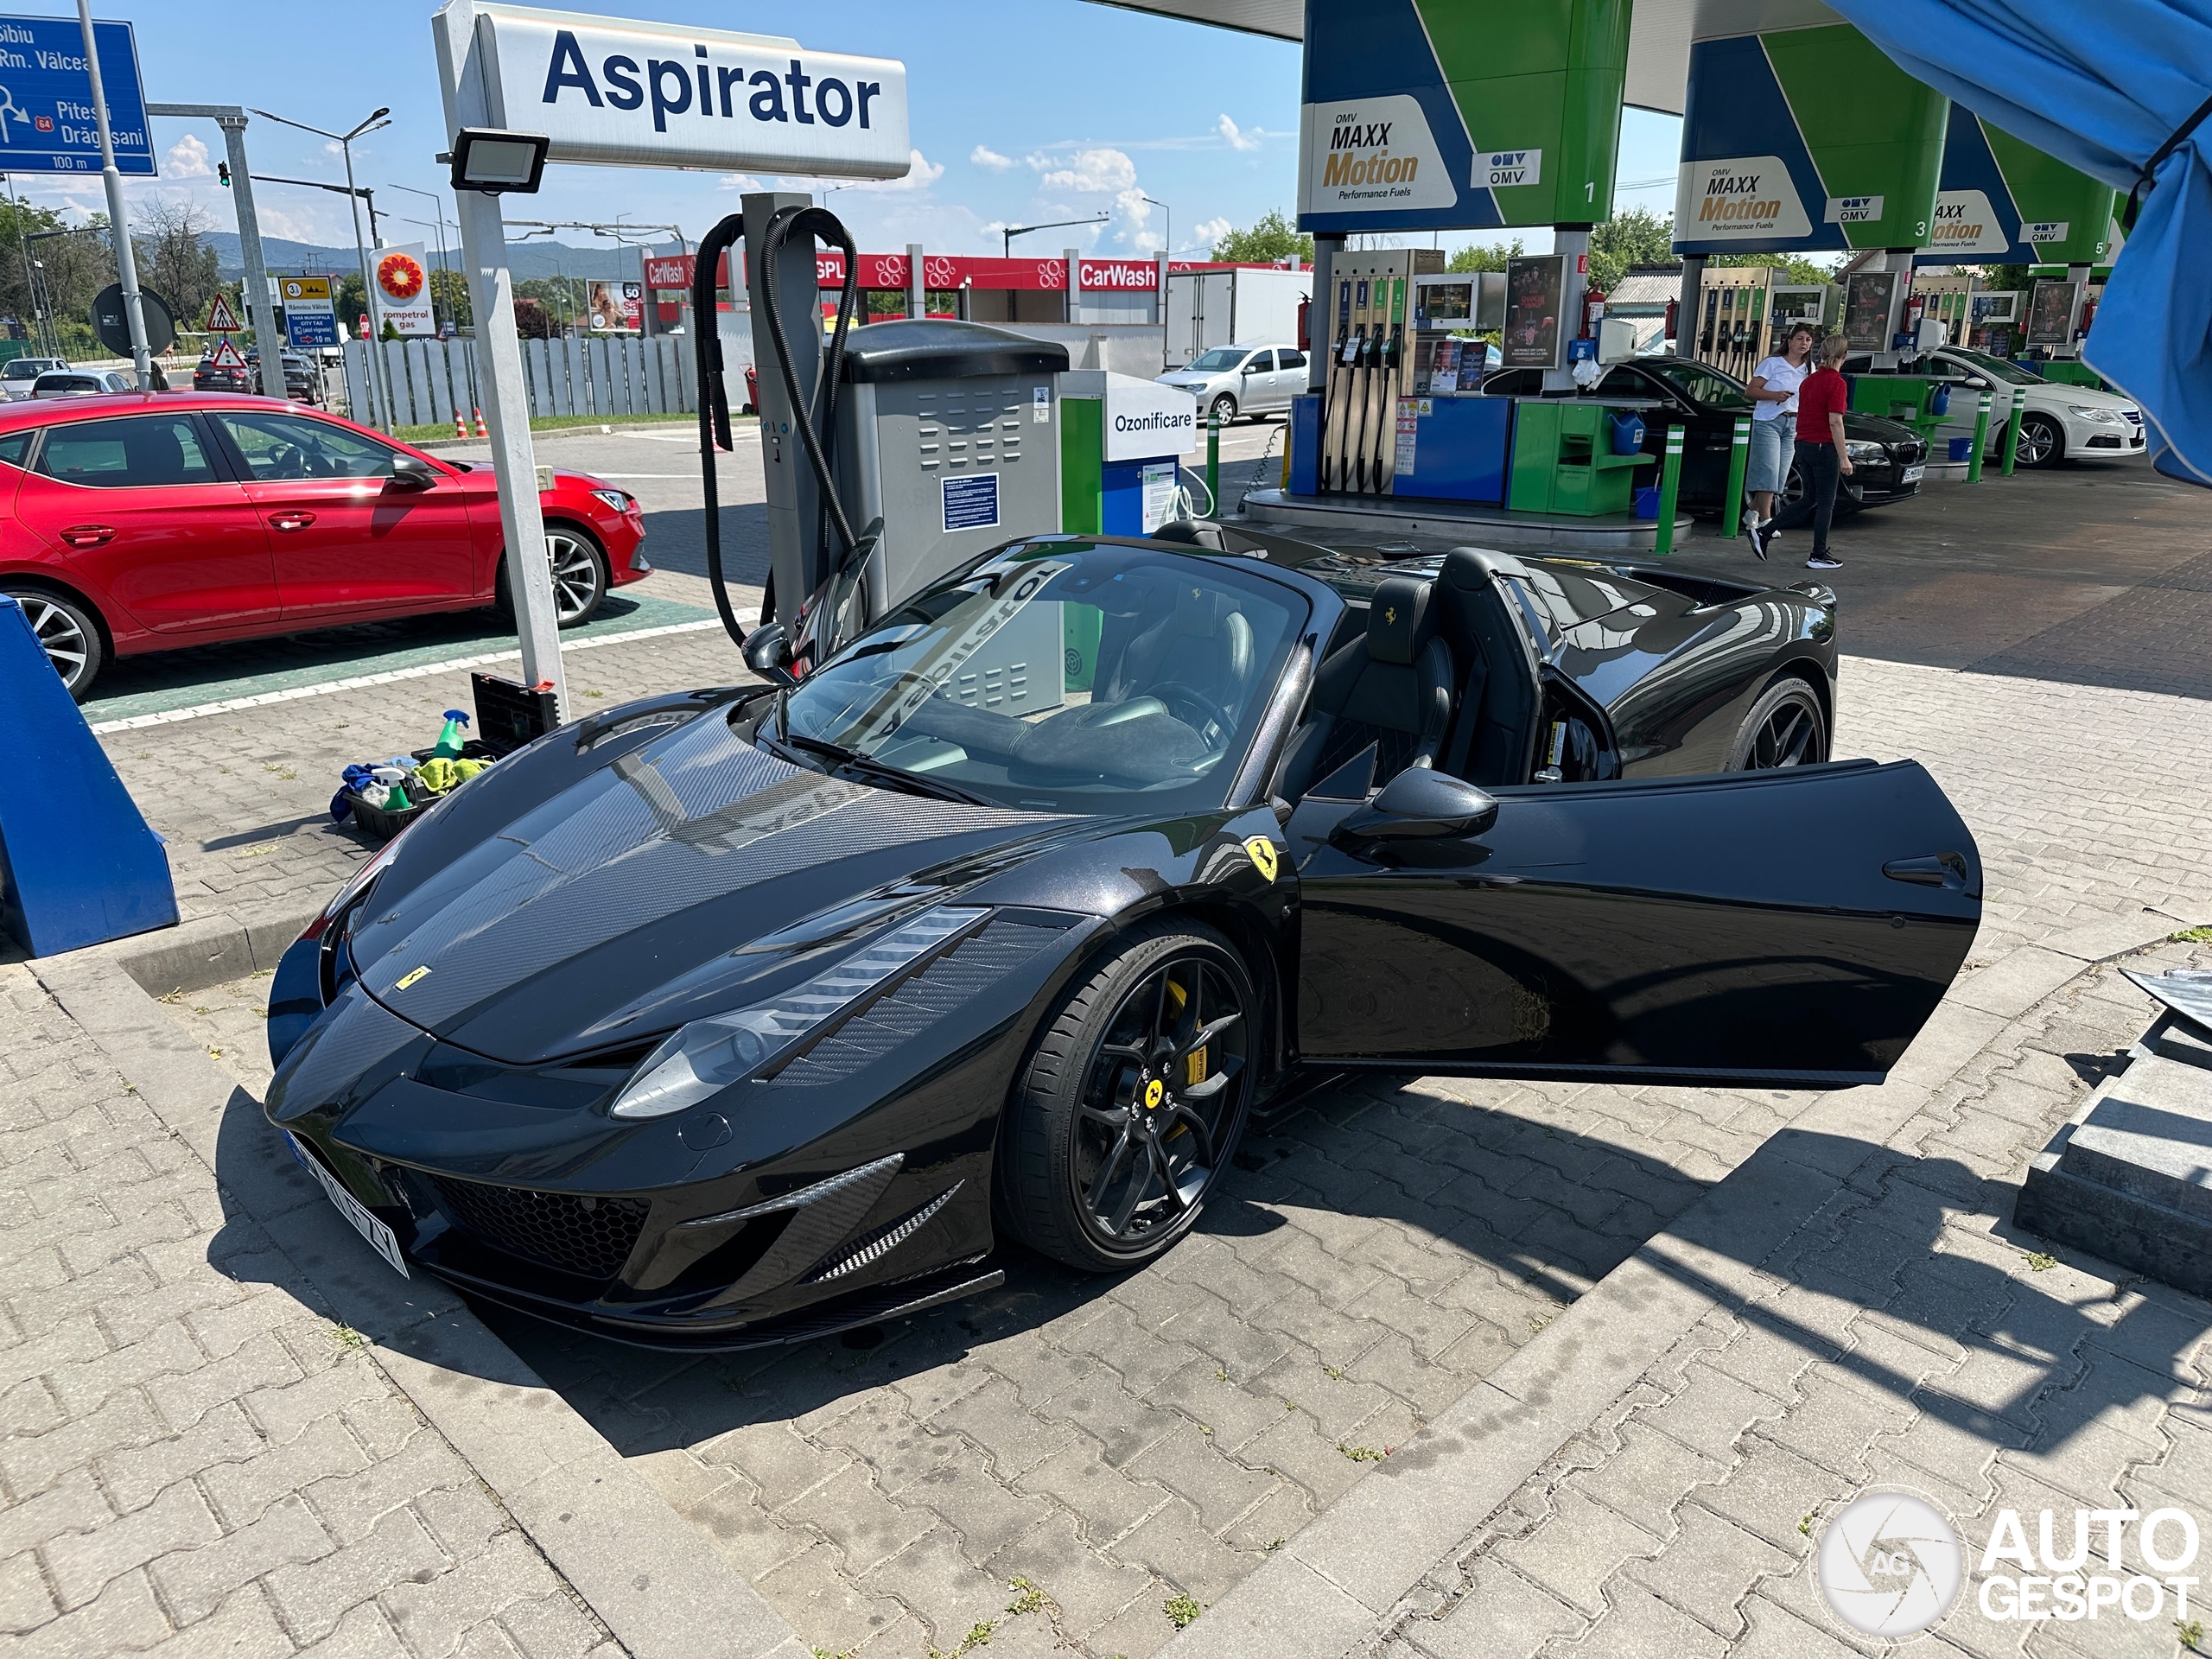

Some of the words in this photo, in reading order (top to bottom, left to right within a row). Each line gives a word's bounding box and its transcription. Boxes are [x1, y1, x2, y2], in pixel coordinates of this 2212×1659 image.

[0, 49, 32, 68] Rm.
[542, 30, 880, 132] Aspirator
[56, 101, 112, 124] Piteși
[1335, 112, 1357, 124] OMV
[39, 119, 50, 129] 64
[60, 125, 144, 149] Drăgșani
[1330, 122, 1393, 149] MAXX
[53, 156, 72, 168] 100
[76, 159, 87, 169] m
[1322, 150, 1419, 187] Motion
[1490, 170, 1524, 184] OMV
[1707, 175, 1761, 195] MAXX
[1338, 188, 1387, 200] Performance
[1389, 186, 1411, 198] Fuels
[1584, 182, 1595, 203] 1
[1699, 194, 1782, 222] Motion
[1840, 210, 1870, 220] OMV
[1934, 204, 1966, 218] AXX
[1711, 222, 1755, 232] Performance
[1757, 220, 1774, 230] Fuels
[1914, 221, 1926, 237] 3
[1932, 219, 1983, 239] otion
[2095, 242, 2104, 254] 5
[649, 262, 684, 284] CarWash
[817, 261, 846, 279] GPL
[1080, 264, 1156, 287] CarWash
[626, 289, 639, 298] 50
[383, 310, 429, 321] rompetrol
[1418, 308, 1422, 316] 1
[399, 321, 415, 330] gas
[1115, 411, 1192, 432] Ozonificare
